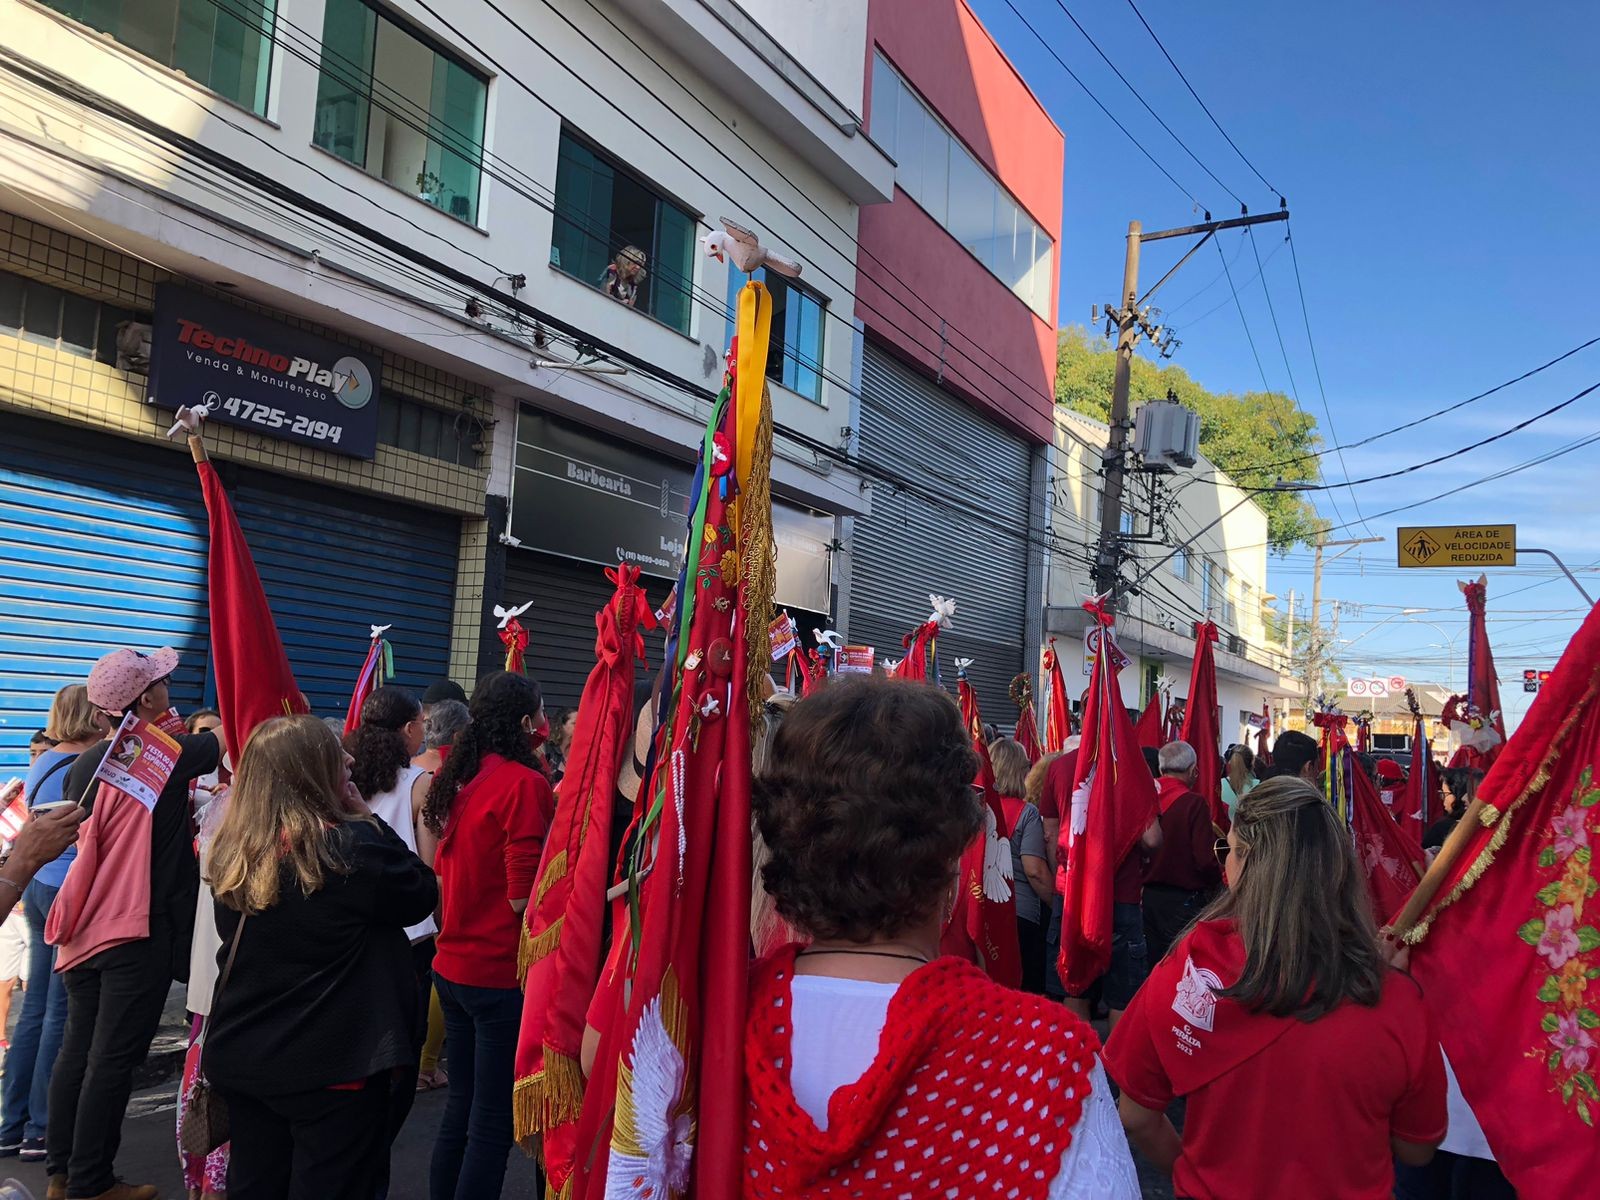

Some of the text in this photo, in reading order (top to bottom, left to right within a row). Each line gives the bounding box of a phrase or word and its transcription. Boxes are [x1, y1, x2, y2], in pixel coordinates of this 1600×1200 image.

[186, 350, 327, 400] Venda & Manutenção
[223, 397, 342, 444] 4725-2194
[567, 461, 632, 496] Barbearia
[1455, 530, 1500, 538] ÁREA DE
[1445, 542, 1510, 550] VELOCIDADE
[143, 751, 167, 771] ESPÍRITO
[146, 744, 163, 759] FESTA
[162, 755, 170, 764] DO
[1172, 1026, 1201, 1048] PERALTA
[1177, 1041, 1192, 1055] 2023
